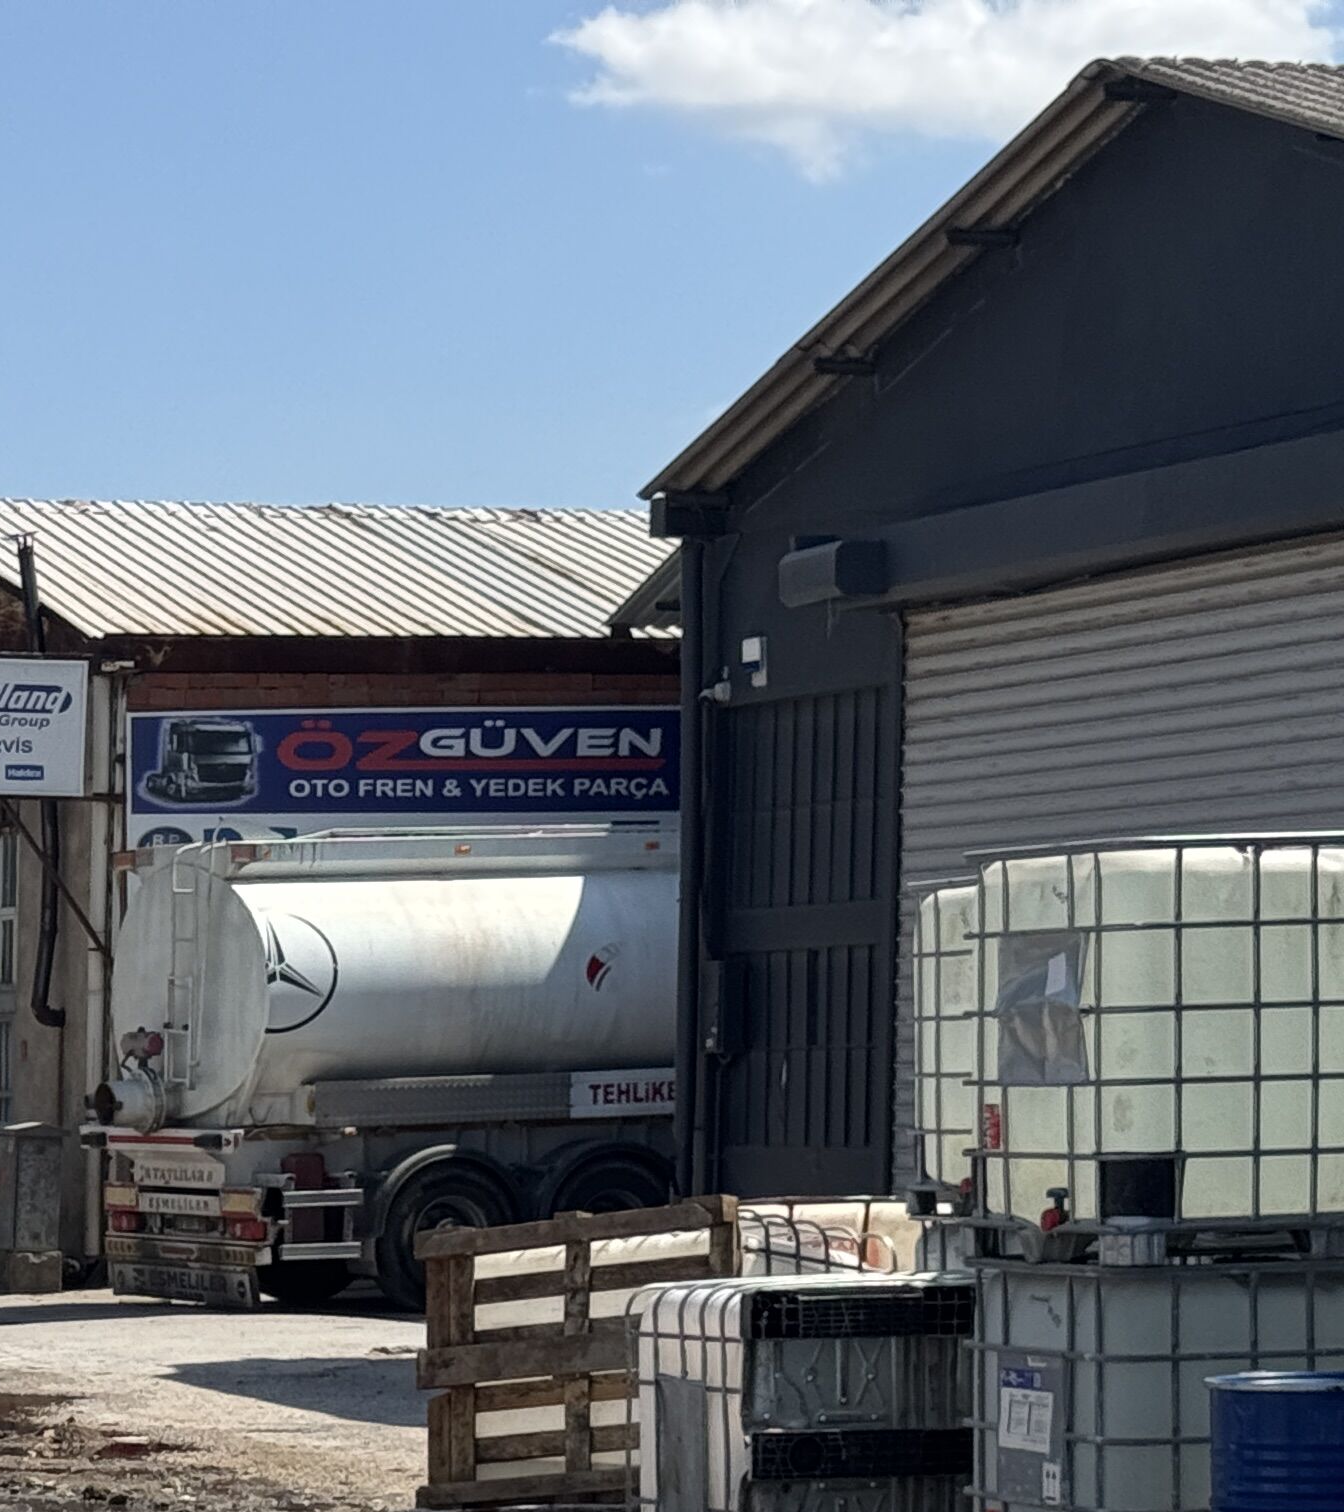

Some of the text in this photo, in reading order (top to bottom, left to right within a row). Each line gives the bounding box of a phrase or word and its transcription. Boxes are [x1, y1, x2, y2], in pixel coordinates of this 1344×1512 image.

[289, 777, 669, 799] OTO FREN & YEDEK PARÇA
